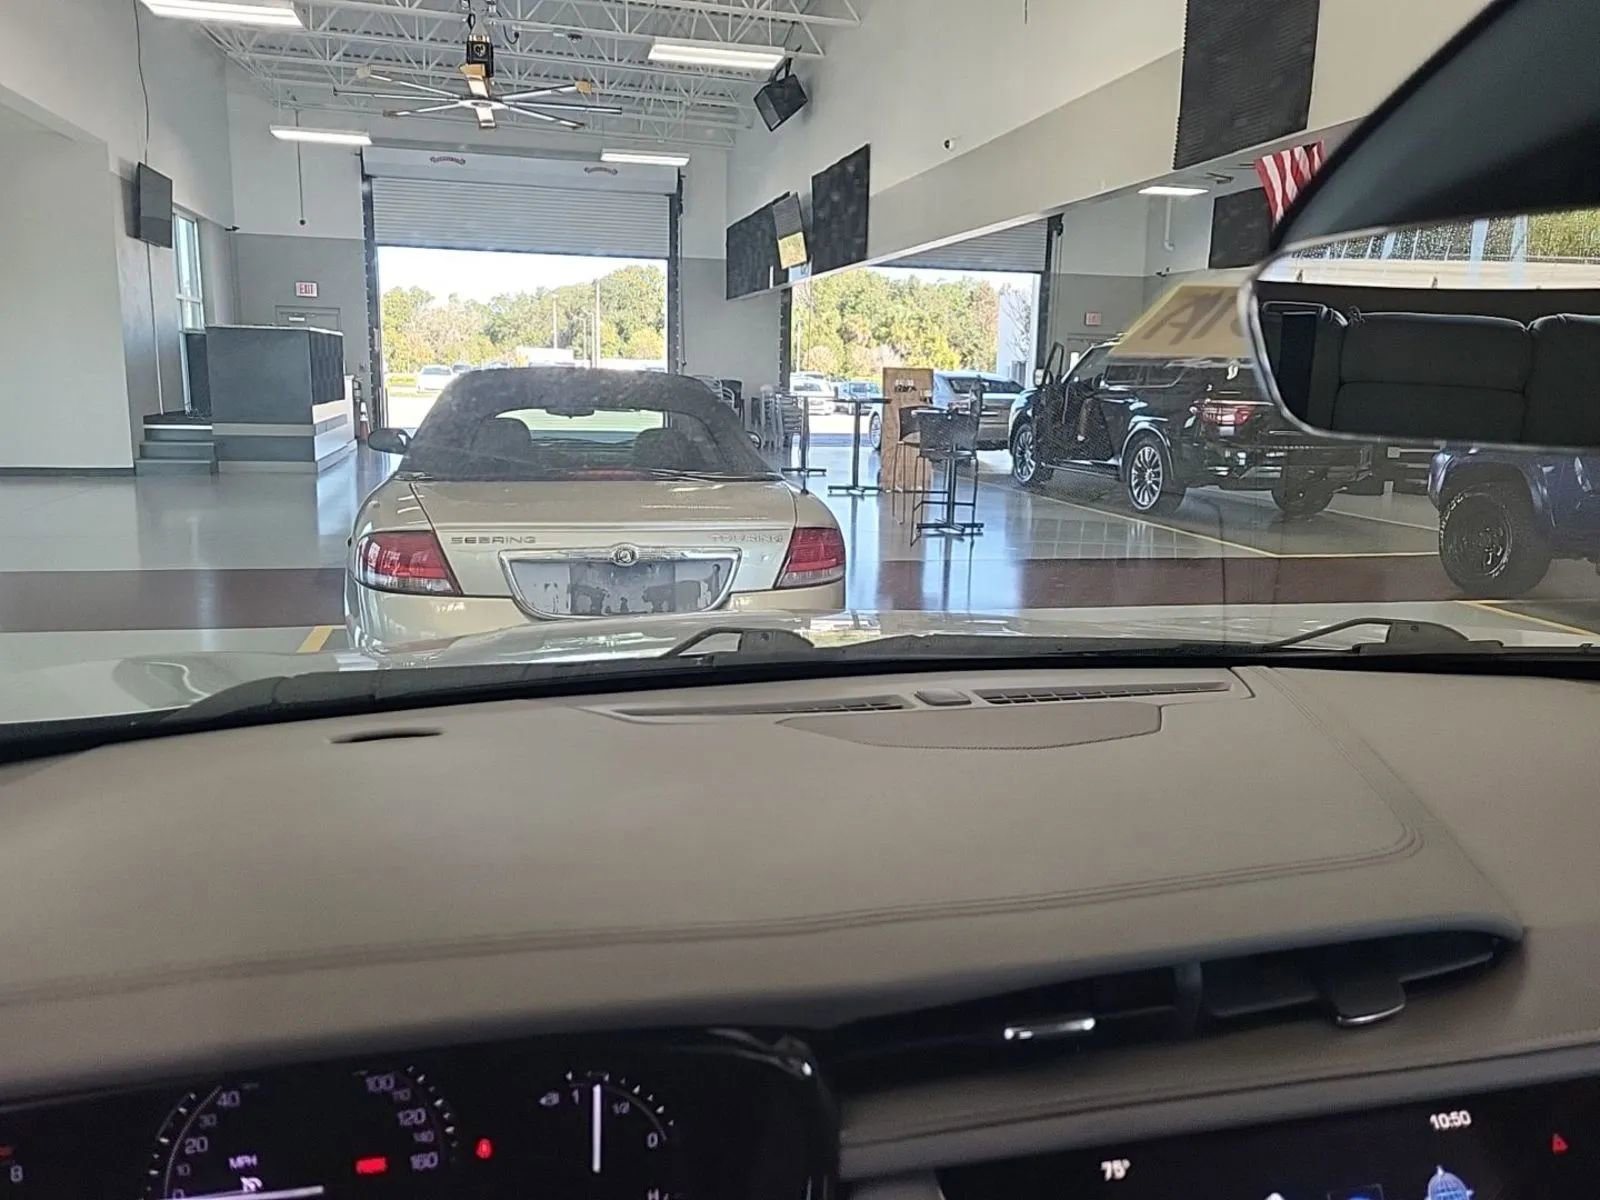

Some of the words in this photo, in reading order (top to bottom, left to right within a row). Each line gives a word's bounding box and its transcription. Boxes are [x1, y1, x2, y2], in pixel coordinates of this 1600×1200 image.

[450, 535, 536, 544] SEBRING
[711, 534, 783, 543] TOURING
[366, 1072, 395, 1092] 100
[217, 1090, 240, 1107] 40
[200, 1113, 217, 1128] 30
[397, 1107, 426, 1126] 120
[1430, 1108, 1472, 1131] 10:50
[185, 1136, 208, 1154] 20
[176, 1163, 191, 1176] 10
[229, 1153, 258, 1169] MPH
[10, 1165, 23, 1182] 8
